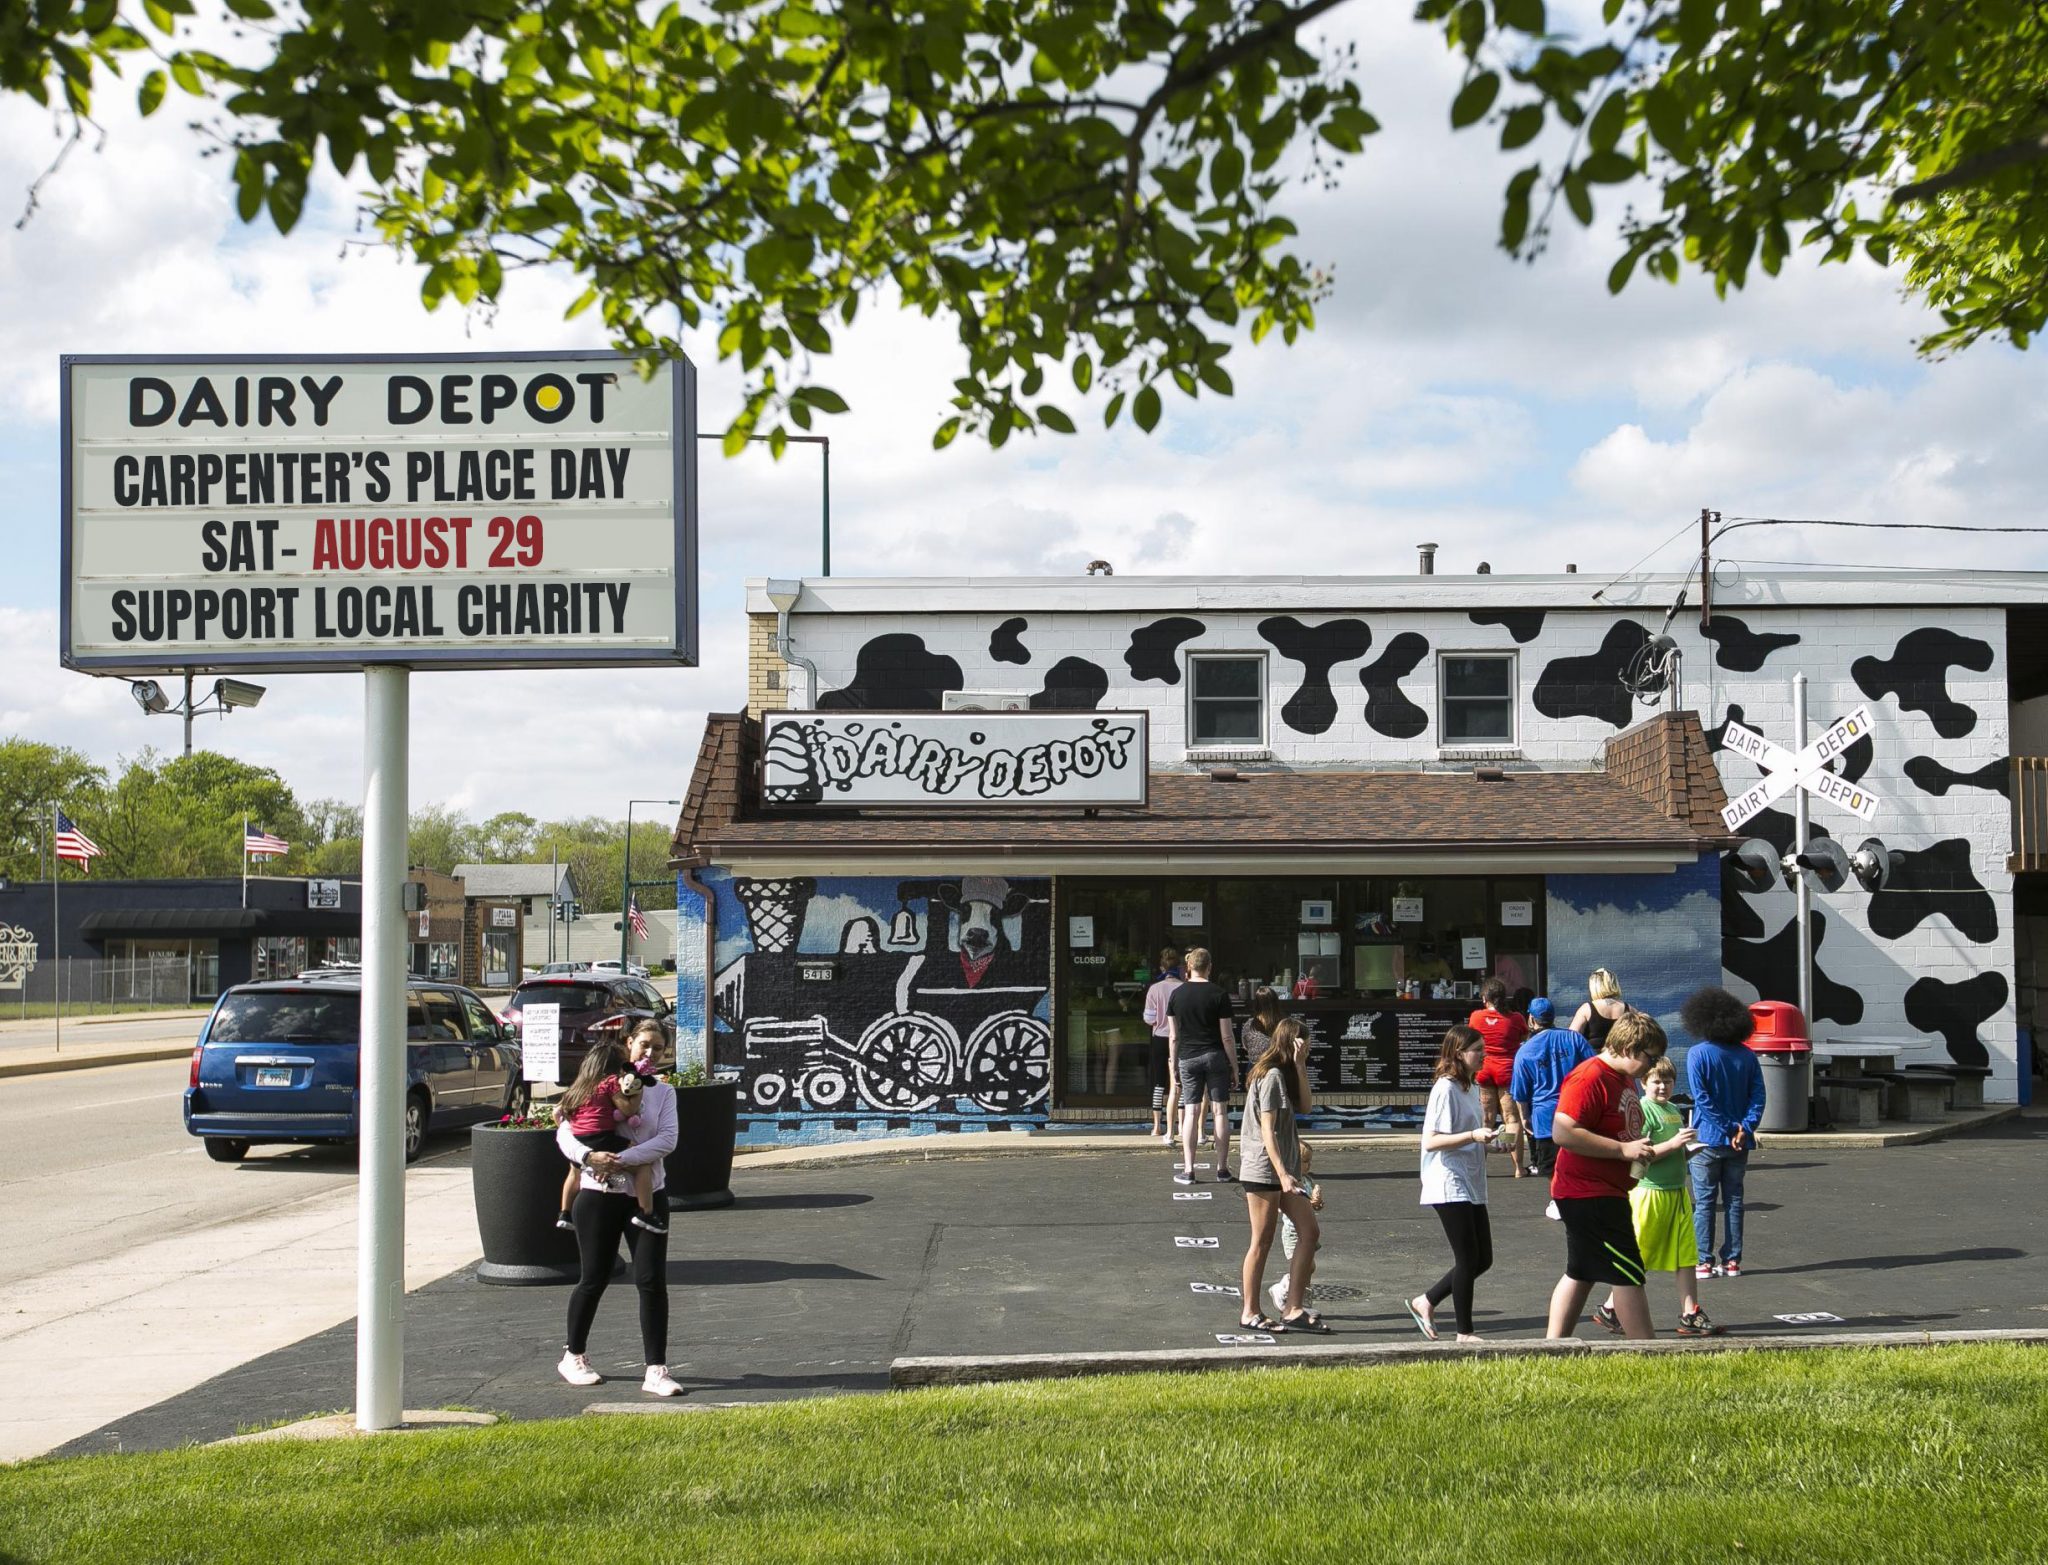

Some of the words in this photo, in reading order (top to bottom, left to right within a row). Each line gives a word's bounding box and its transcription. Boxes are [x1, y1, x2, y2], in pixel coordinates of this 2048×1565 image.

[129, 376, 344, 428] DAIRY
[387, 372, 618, 425] DEPOT
[113, 450, 391, 507] CARPENTER'S
[406, 448, 536, 503] PLACE
[550, 447, 631, 500] DAY
[201, 519, 297, 572] SAT-
[312, 517, 473, 571] AUGUST
[487, 515, 544, 568] 29
[111, 587, 300, 642] SUPPORT
[314, 585, 444, 638] LOCAL
[457, 582, 631, 637] CHARITY
[1727, 727, 1770, 760] DAIRY
[1816, 710, 1869, 760] DEPOT
[819, 728, 984, 794] DAIRY
[977, 726, 1136, 799] DEPOT
[1726, 784, 1769, 826] DAIRY
[1818, 775, 1874, 814] DEPOT
[804, 970, 831, 979] 5413
[1073, 956, 1106, 964] CLOSED
